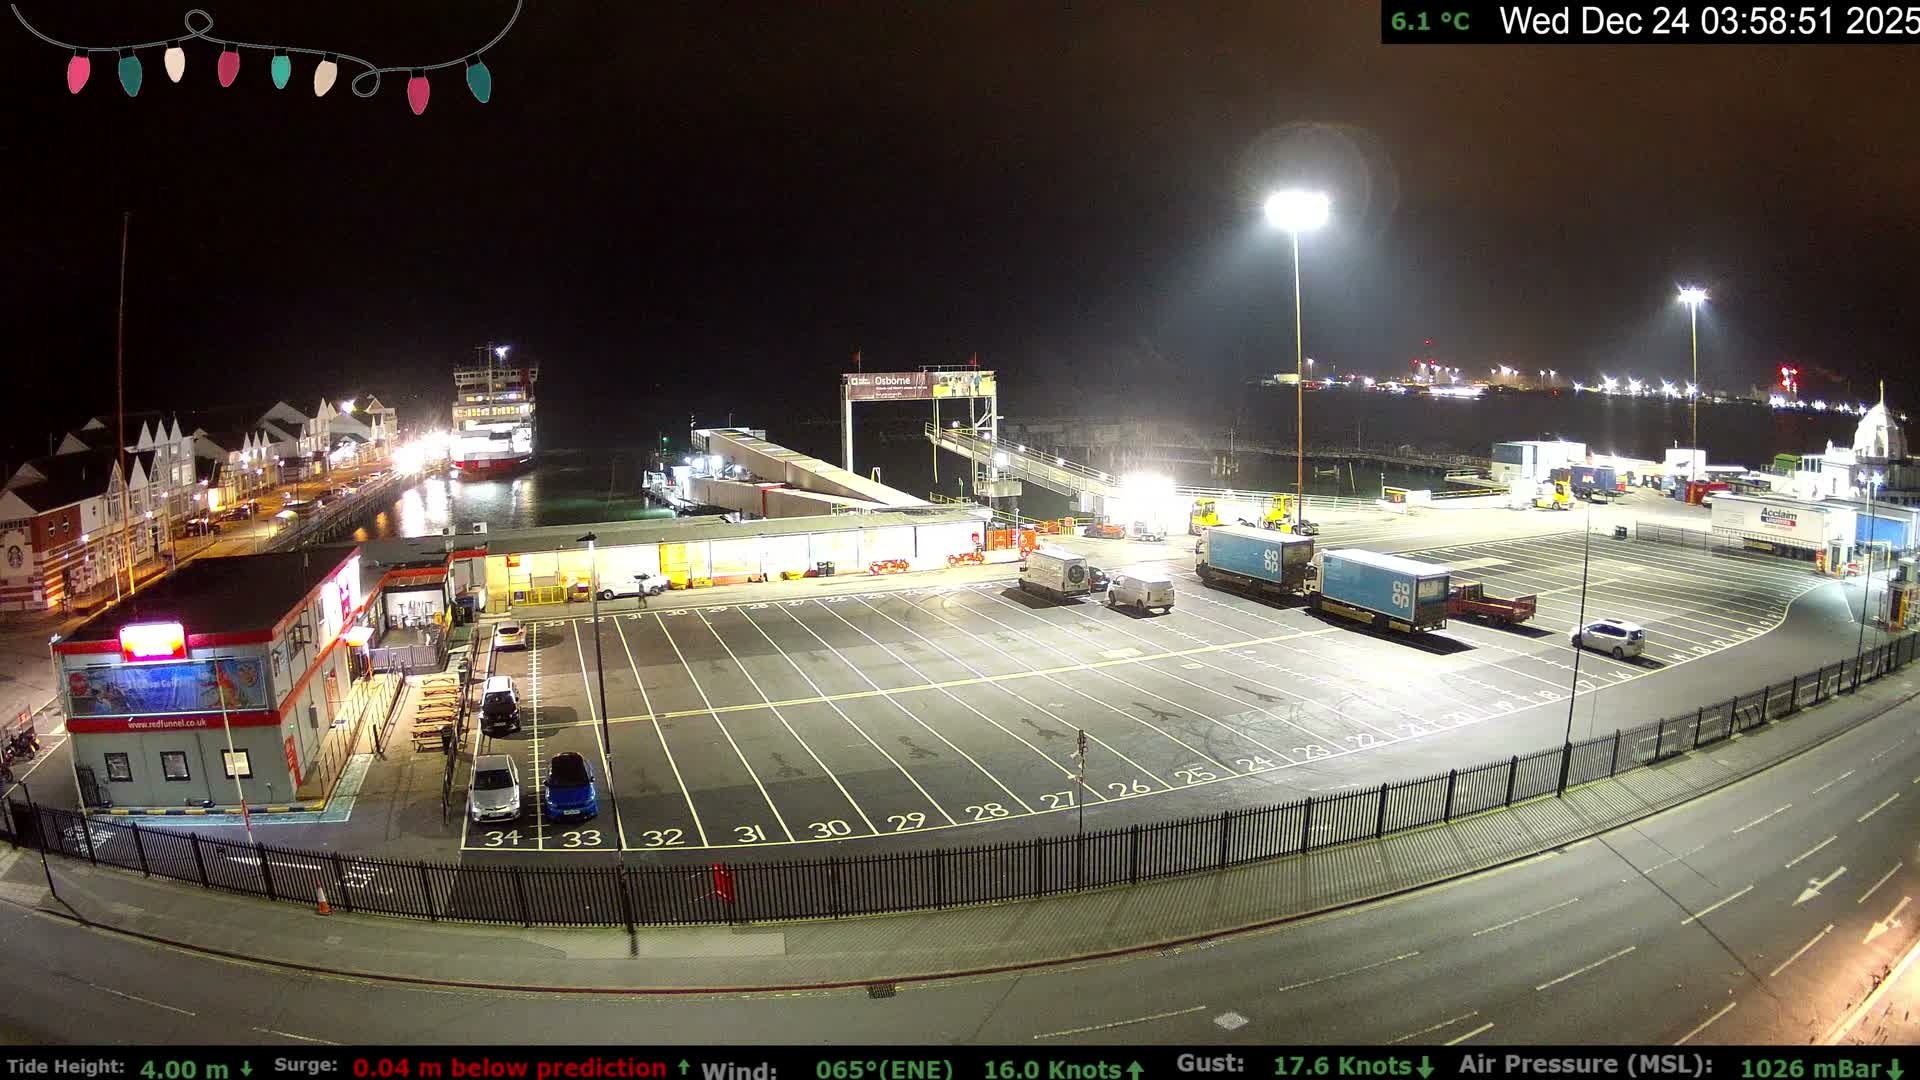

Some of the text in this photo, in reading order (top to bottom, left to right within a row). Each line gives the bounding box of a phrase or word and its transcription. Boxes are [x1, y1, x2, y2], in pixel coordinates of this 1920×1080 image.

[875, 376, 911, 385] Osborne
[1761, 507, 1797, 520] Acclaim
[128, 719, 207, 729] www.redfunnel.co.uk
[1292, 744, 1331, 760] 23
[1236, 755, 1275, 772] 24
[1174, 766, 1217, 785] 25
[1108, 779, 1151, 797] 26
[1040, 790, 1075, 809] 27
[964, 802, 1009, 822] 28
[808, 819, 852, 840] 30
[887, 812, 926, 832] 29
[484, 829, 523, 848] 34
[562, 829, 602, 848] 33
[642, 828, 685, 847] 32
[733, 824, 768, 843] 31
